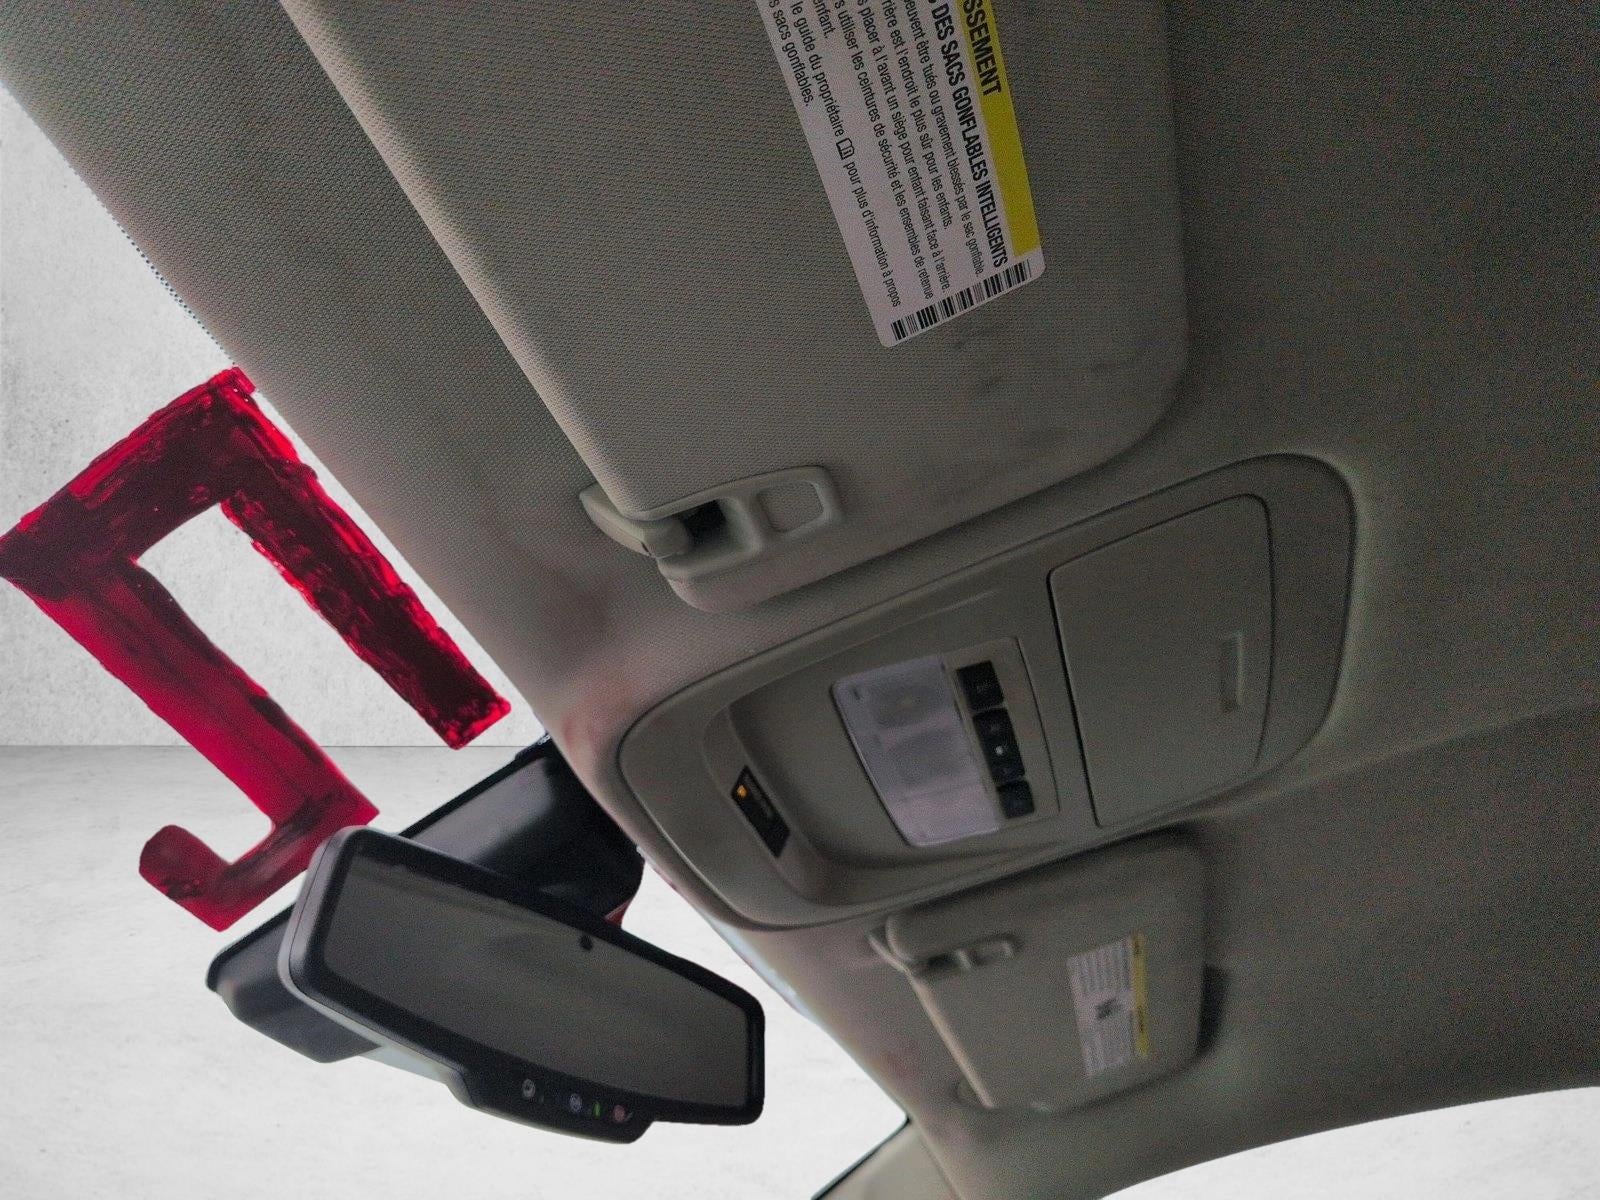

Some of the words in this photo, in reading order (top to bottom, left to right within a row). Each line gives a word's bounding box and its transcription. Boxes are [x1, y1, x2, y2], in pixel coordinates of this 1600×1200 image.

[790, 1, 804, 15] le
[772, 9, 792, 41] sacs
[793, 17, 816, 52] guide
[837, 10, 860, 50] utiliser
[858, 7, 880, 44] placer
[931, 3, 955, 41] DES
[872, 44, 886, 56] à
[890, 29, 906, 50] est
[916, 40, 930, 64] être
[808, 53, 823, 71] du
[851, 50, 865, 71] les
[896, 49, 919, 97] l'endroit
[940, 40, 966, 87] SACS
[781, 42, 814, 107] gonflables.
[875, 54, 897, 96] l'avant
[922, 63, 938, 90] tués
[812, 71, 845, 137] propriétaire
[857, 71, 881, 122] ceintures
[886, 95, 900, 111] un
[909, 95, 921, 109] le
[928, 90, 941, 105] ou
[873, 123, 887, 138] de
[891, 111, 908, 141] siège
[910, 109, 927, 133] plus
[930, 105, 956, 160] gravement
[952, 86, 989, 181] GONFLABLES
[897, 141, 915, 165] pour
[919, 132, 934, 151] sûr
[878, 138, 899, 179] sécurité
[921, 151, 940, 175] pour
[843, 161, 862, 186] pour
[890, 179, 903, 192] et
[907, 165, 928, 199] enfant
[931, 174, 944, 192] les
[947, 157, 966, 195] blessés
[851, 186, 869, 209] plus
[894, 189, 907, 207] les
[954, 196, 969, 211] par
[916, 197, 935, 231] faisant
[935, 191, 953, 230] enfants.
[961, 210, 972, 222] le
[899, 207, 921, 256] ensembles
[963, 221, 975, 239] sac
[975, 180, 1008, 268] INTELLIGENTS
[861, 209, 890, 271] d'information
[926, 229, 940, 250] face
[914, 255, 925, 268] de
[931, 249, 944, 258] à
[882, 269, 894, 278] à
[918, 266, 934, 300] retenue
[882, 279, 901, 308] propos
